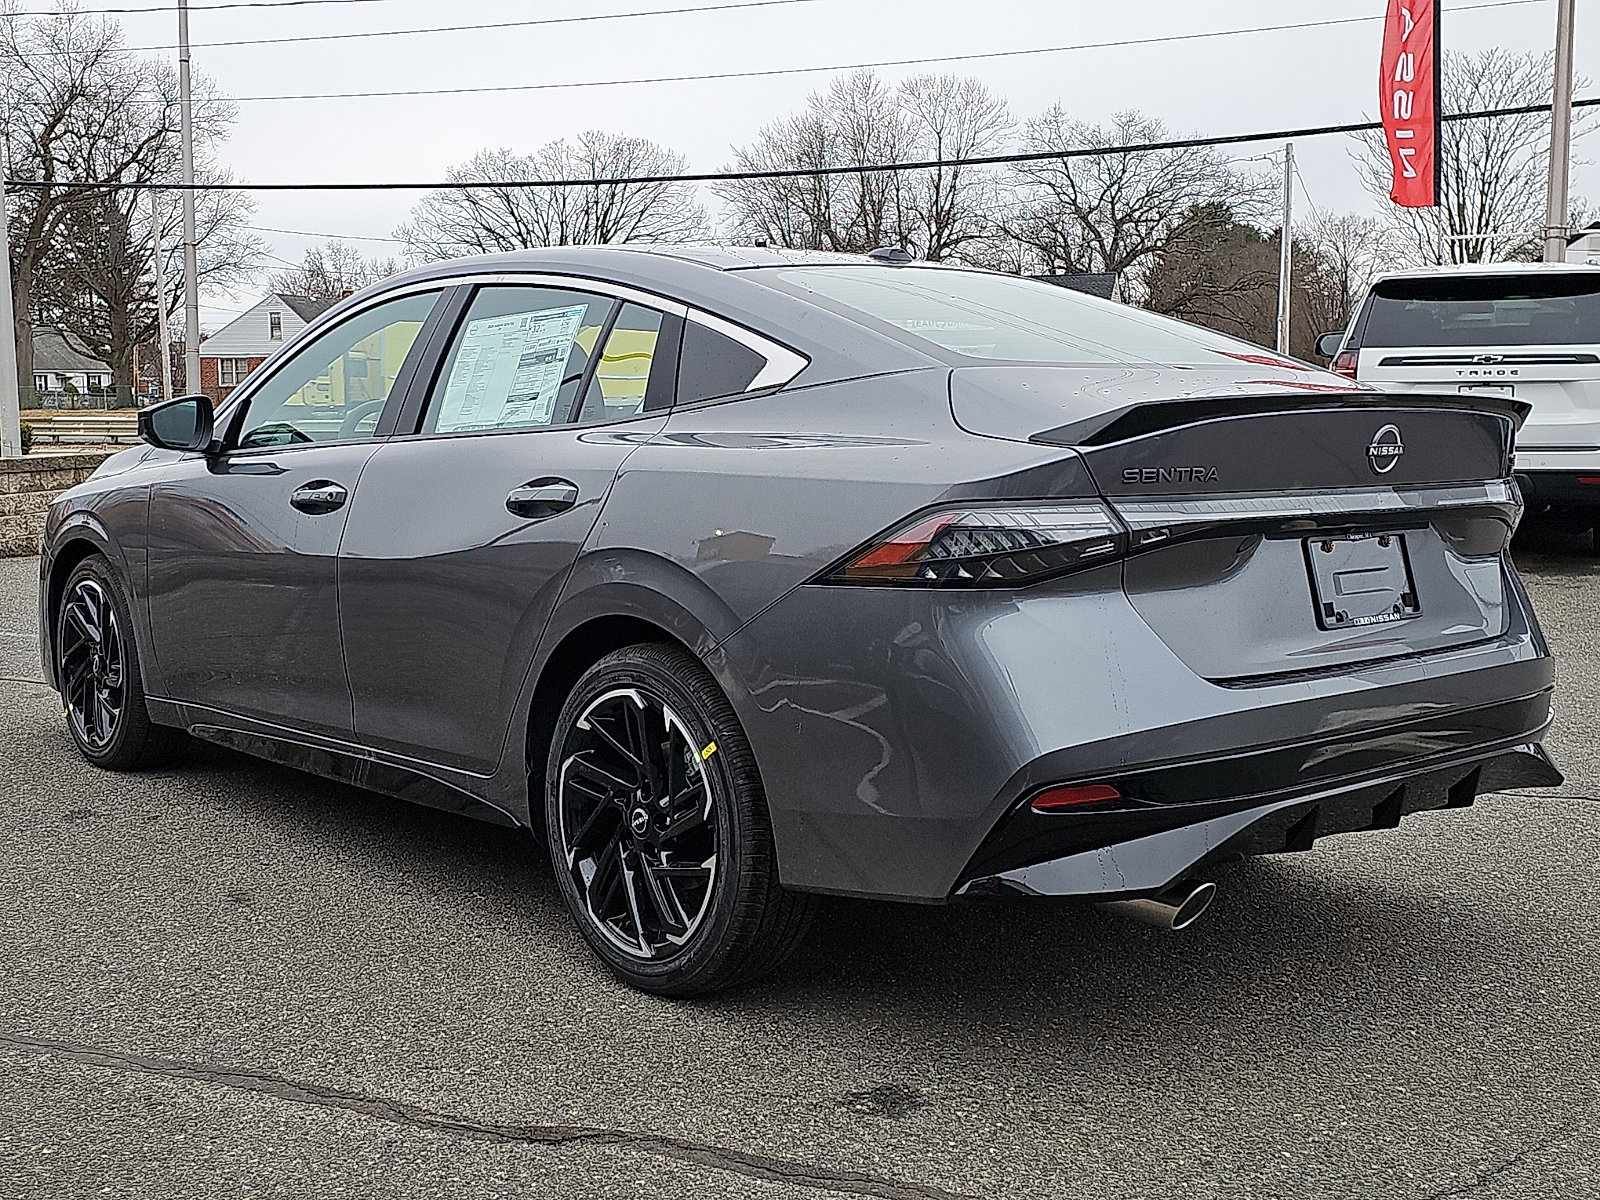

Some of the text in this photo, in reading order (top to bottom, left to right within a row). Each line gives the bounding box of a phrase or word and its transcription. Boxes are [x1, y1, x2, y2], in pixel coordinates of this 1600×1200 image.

[1369, 446, 1404, 456] NISSAN
[1121, 465, 1220, 484] SENTRA
[1370, 611, 1400, 624] NISSAN
